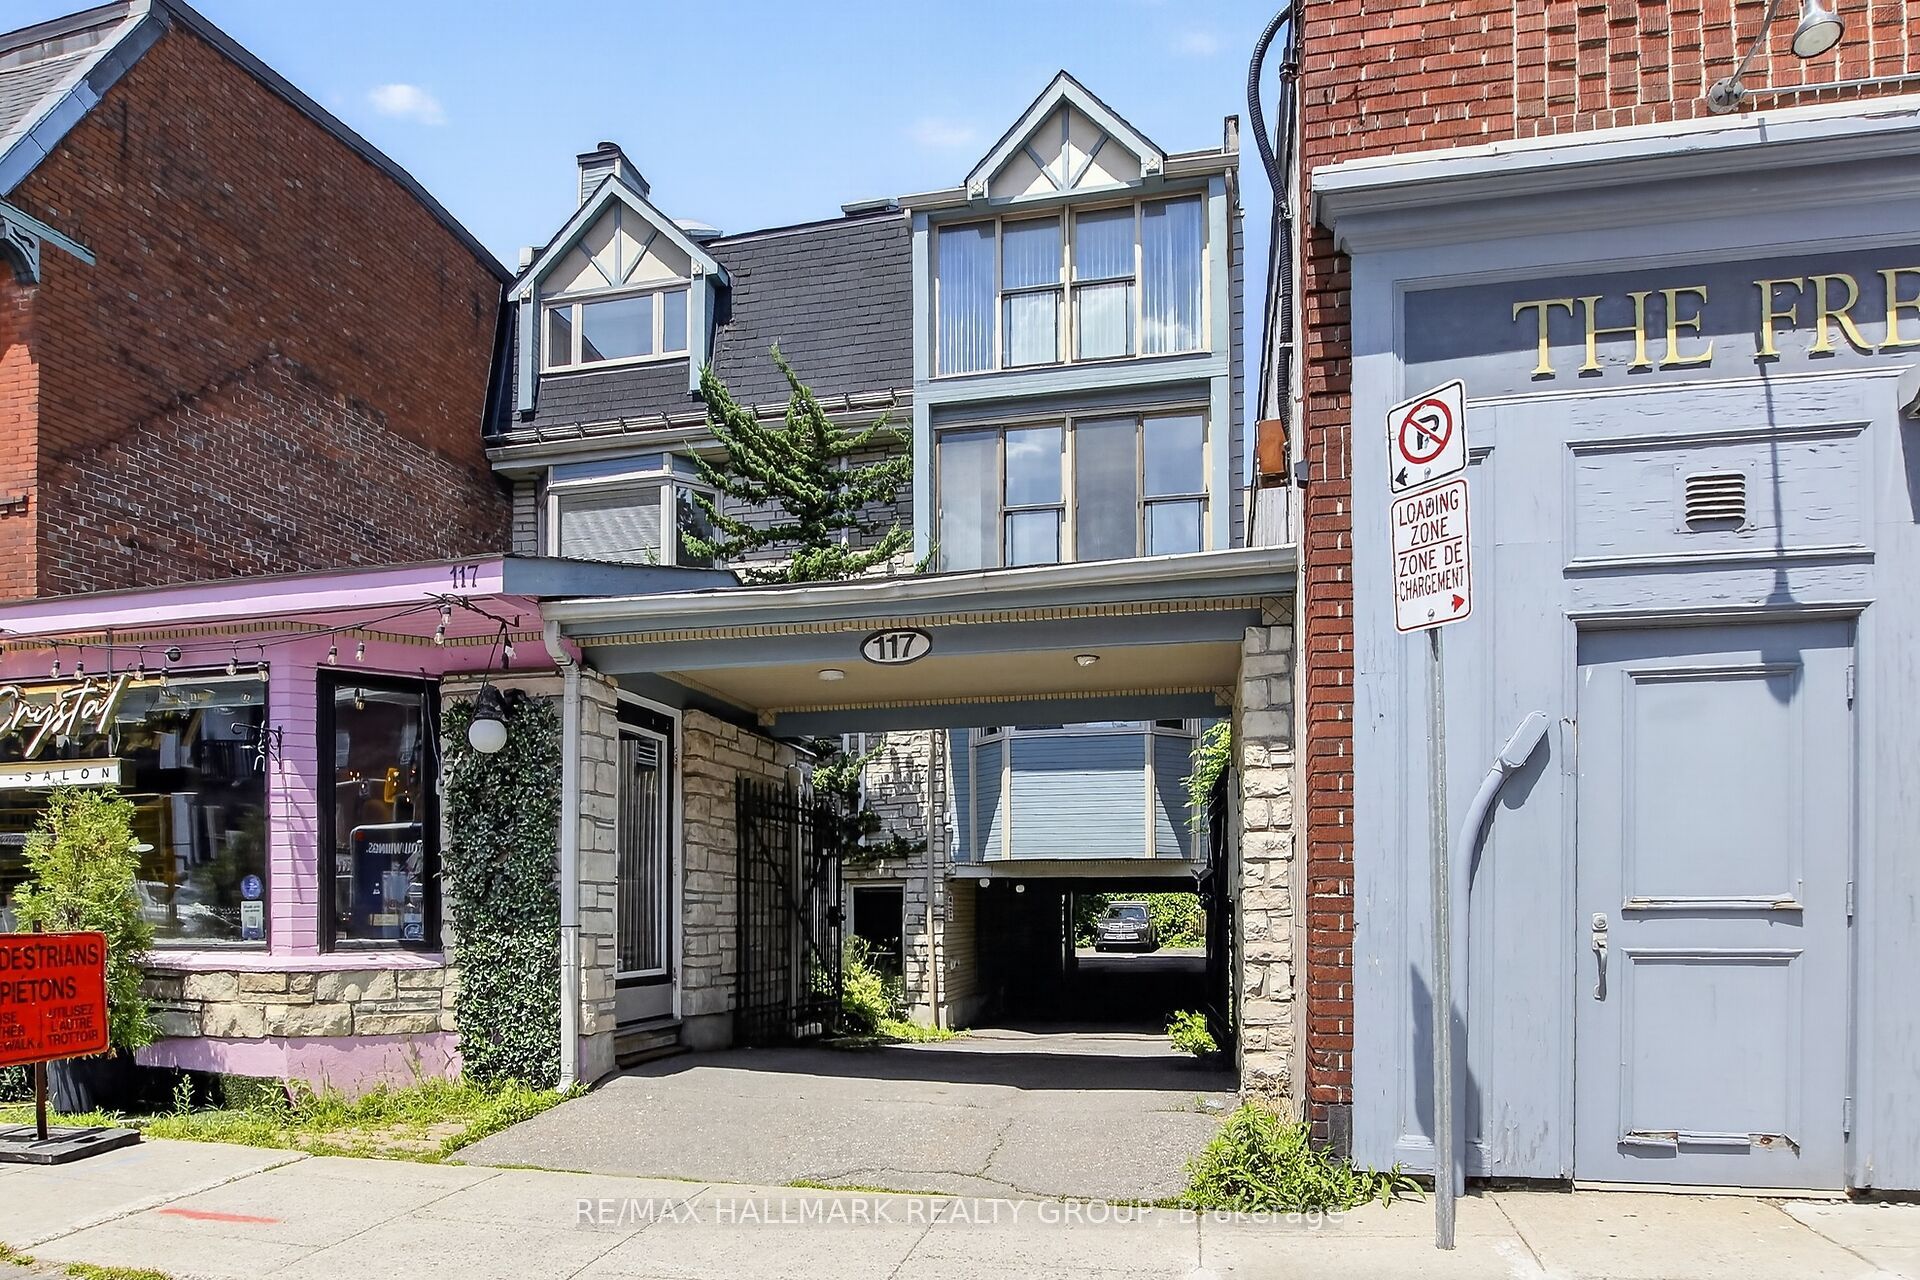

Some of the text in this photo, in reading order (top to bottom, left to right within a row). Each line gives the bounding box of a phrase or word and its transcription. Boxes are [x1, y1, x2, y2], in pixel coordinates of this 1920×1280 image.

[1513, 266, 1920, 377] THE FRE
[1399, 489, 1459, 526] LOADING
[1411, 516, 1449, 546] ZONE
[1399, 541, 1463, 577] ZONE DE
[450, 564, 479, 589] 117
[1399, 566, 1464, 602] CHARGEMENT
[873, 633, 917, 660] 117
[0, 1011, 17, 1024] SE
[47, 1029, 98, 1046] TROTTOIR
